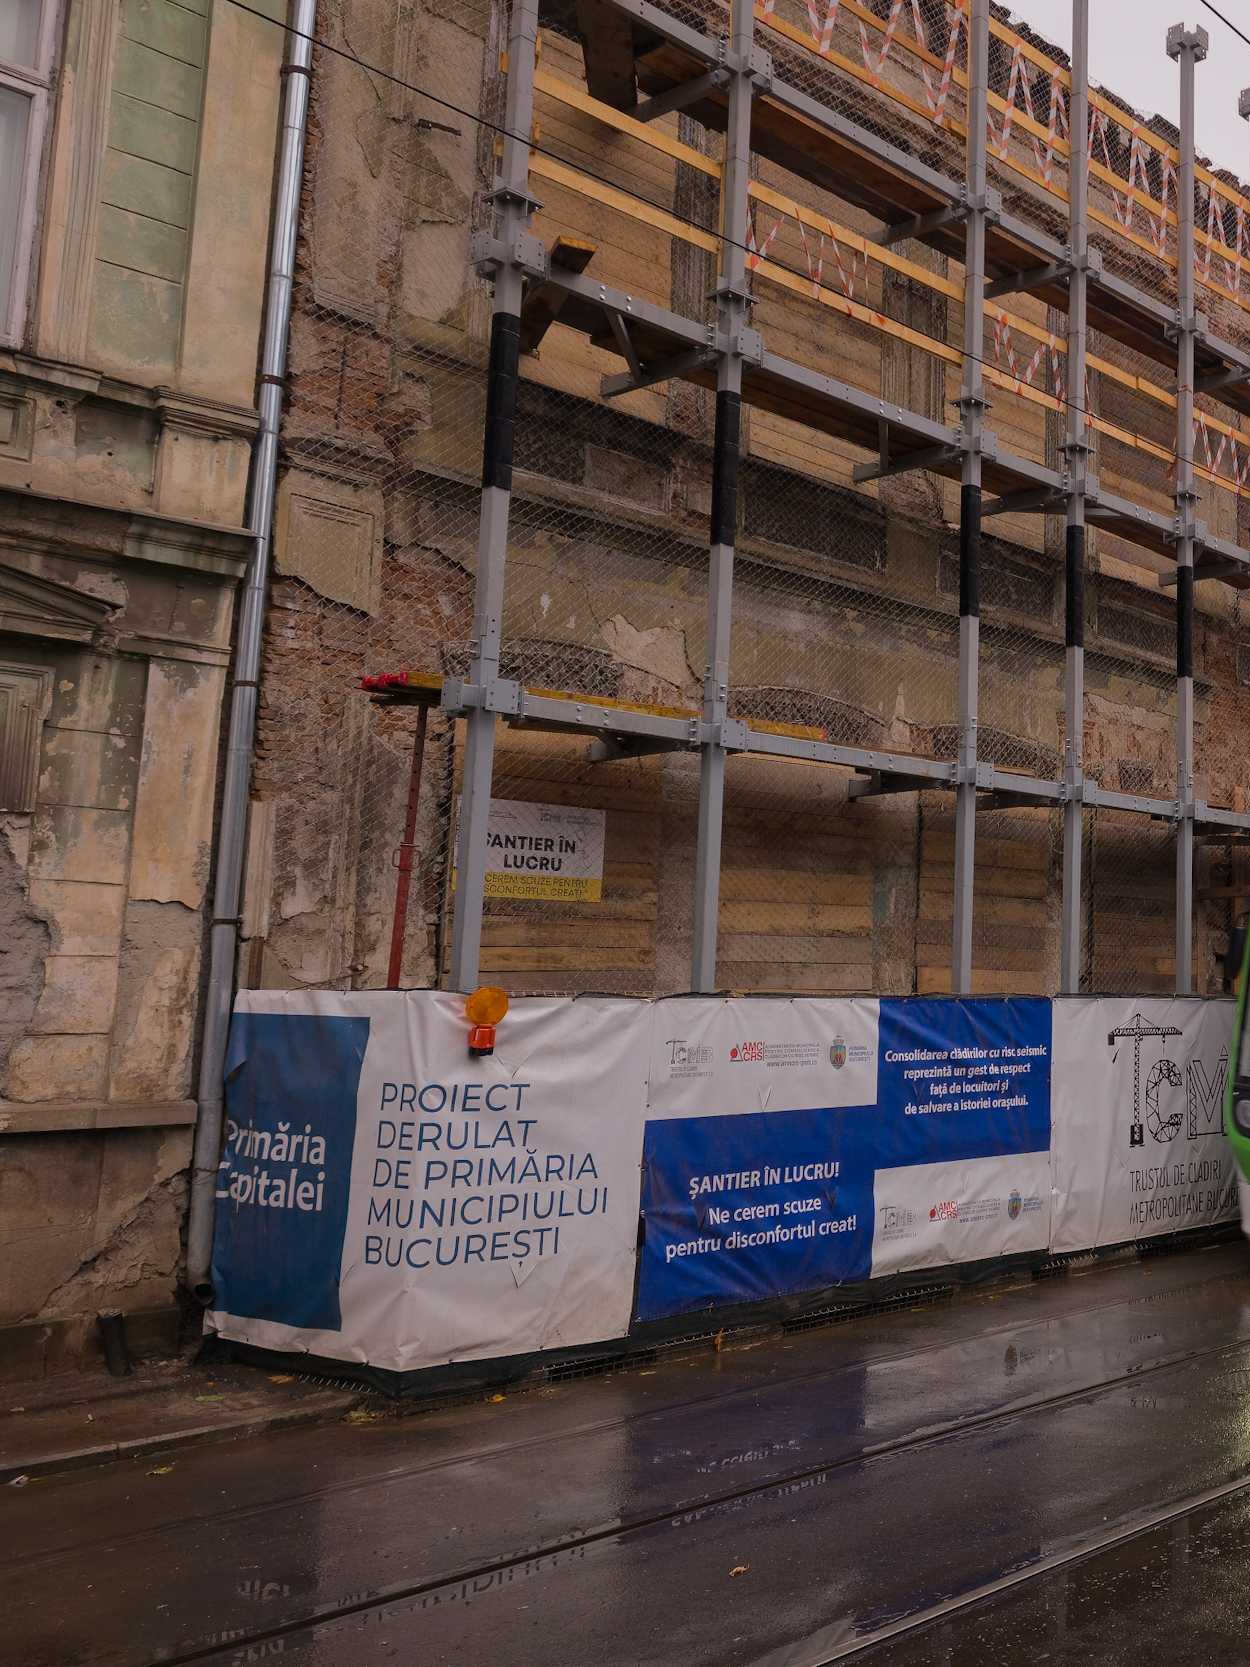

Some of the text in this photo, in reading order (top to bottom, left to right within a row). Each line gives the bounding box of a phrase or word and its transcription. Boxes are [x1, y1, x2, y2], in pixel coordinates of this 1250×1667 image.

[559, 836, 576, 854] ÎN
[504, 854, 562, 872] LUCRU
[521, 876, 550, 885] SCUZE
[553, 878, 588, 888] PENTRU
[742, 1042, 762, 1052] AMC
[744, 1052, 762, 1062] CRS
[885, 1044, 1047, 1062] Consolidarea clădirilor cu risc seismic
[904, 1062, 1031, 1082] reprezintă un gest de respect
[949, 1082, 961, 1094] de
[963, 1080, 1000, 1093] locuitori
[1001, 1080, 1009, 1093] și
[380, 1083, 530, 1113] PROIECT
[905, 1095, 1029, 1115] de salvare a istoriei orașului.
[376, 1120, 537, 1151] DERULAT
[373, 1149, 598, 1190] DE PRIMĂRIA
[1130, 1160, 1222, 1192] TRUSTUL DE CLADIRI
[689, 1162, 840, 1199] ȘANTIER ÎN LUCRU!
[367, 1187, 608, 1230] MUNICIPIULUI
[708, 1198, 822, 1226] Ne cerem scuze
[938, 1201, 957, 1211] AMC
[940, 1210, 957, 1220] CRS
[1129, 1192, 1204, 1225] METROPOLITANE
[365, 1226, 560, 1269] BUCUREȘTI
[666, 1216, 857, 1262] pentru disconfortul creat!
